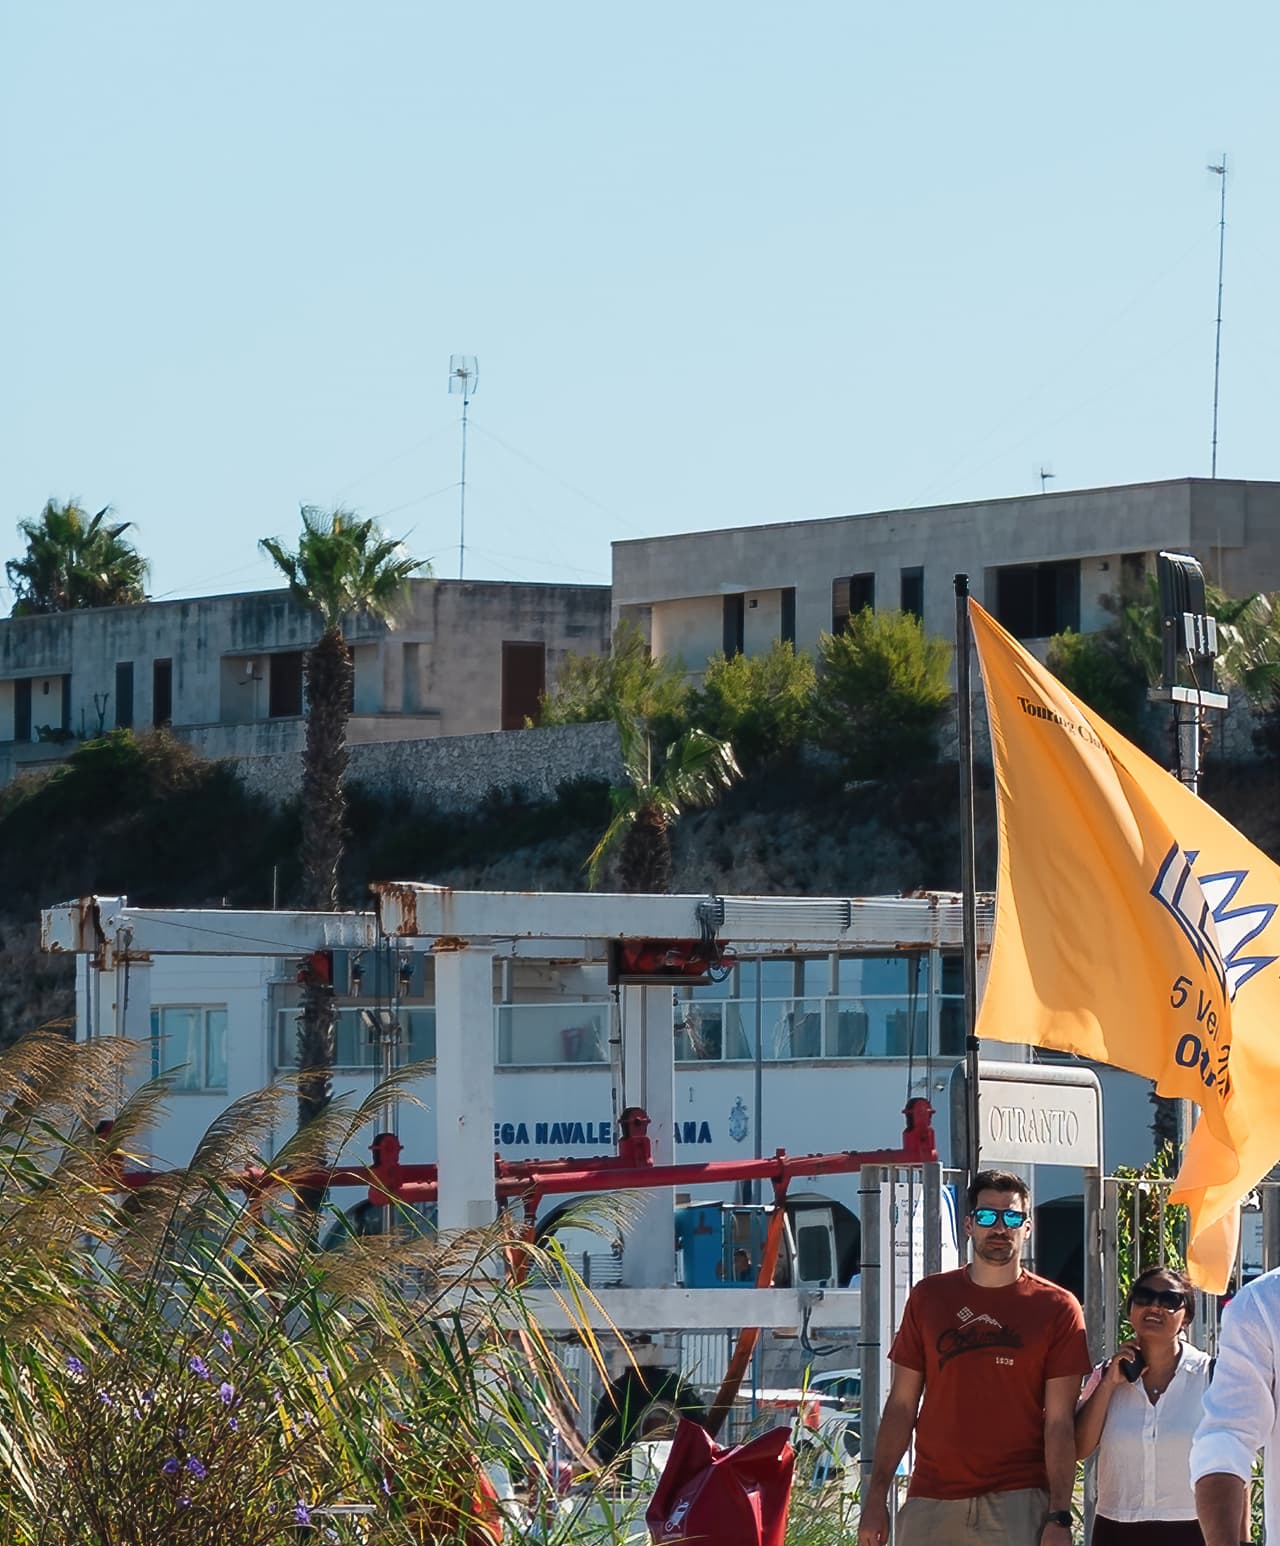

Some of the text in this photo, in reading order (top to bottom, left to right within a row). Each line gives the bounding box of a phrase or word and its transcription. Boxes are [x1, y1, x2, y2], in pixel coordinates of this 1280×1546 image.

[1169, 975, 1194, 1010] 5
[534, 1121, 612, 1146] NAVALE
[988, 1104, 1080, 1147] OTRANTO
